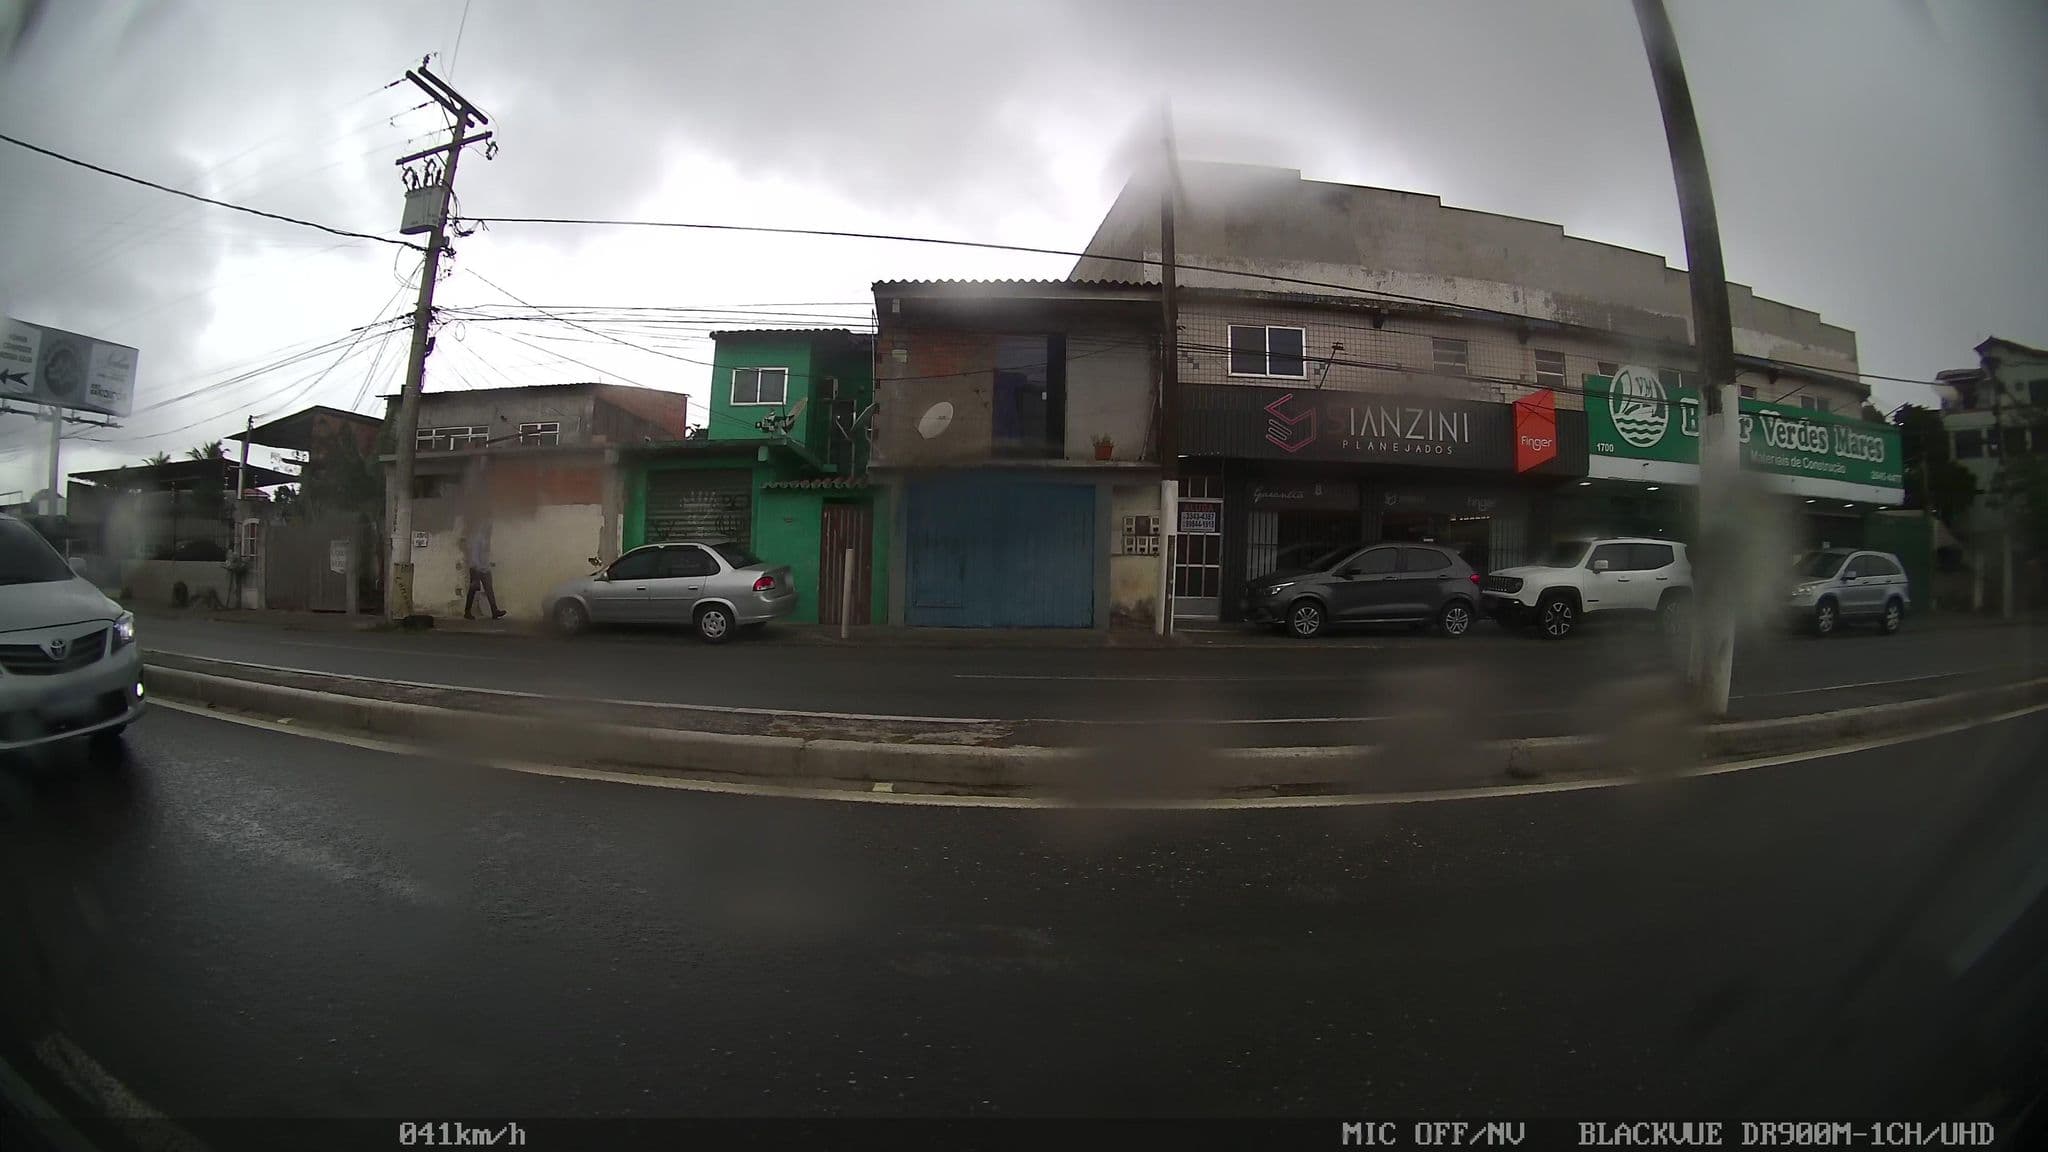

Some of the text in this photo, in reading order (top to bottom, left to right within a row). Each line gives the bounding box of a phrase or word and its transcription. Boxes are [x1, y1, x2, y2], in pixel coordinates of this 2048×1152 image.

[1328, 404, 1470, 443] SIANZINI
[1521, 435, 1553, 452] Finger
[1759, 410, 1829, 454] Verdes
[1835, 425, 1885, 463] Mares
[1341, 440, 1455, 455] PLANEJADOS
[1596, 443, 1615, 453] 1700
[1751, 450, 1790, 466] Materiais
[1791, 456, 1802, 468] de
